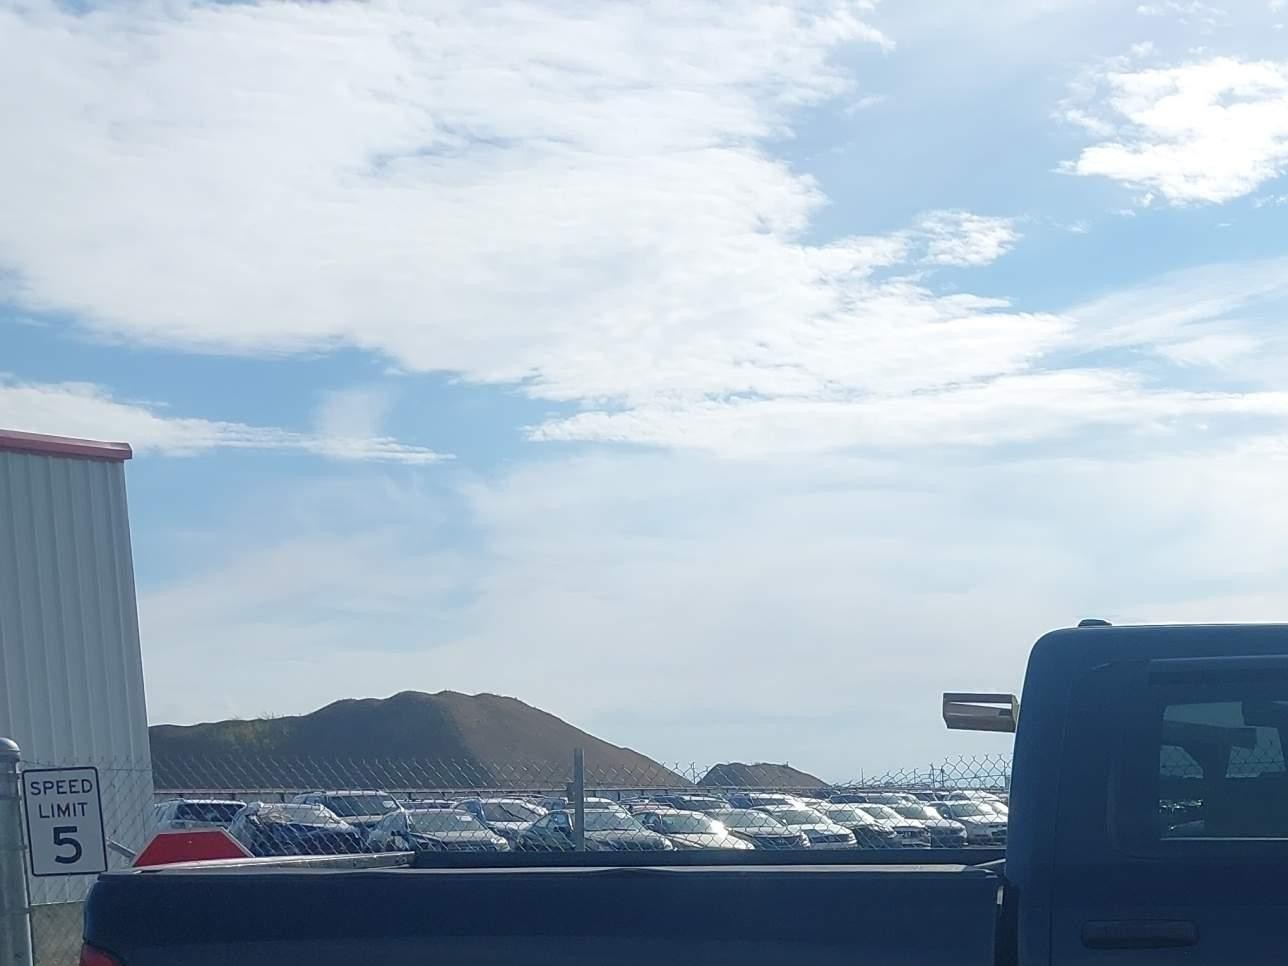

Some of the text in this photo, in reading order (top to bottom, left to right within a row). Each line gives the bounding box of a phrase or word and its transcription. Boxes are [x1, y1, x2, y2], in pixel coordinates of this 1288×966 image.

[30, 779, 93, 796] SPEED
[38, 802, 88, 818] LIMIT
[53, 826, 82, 864] 5
